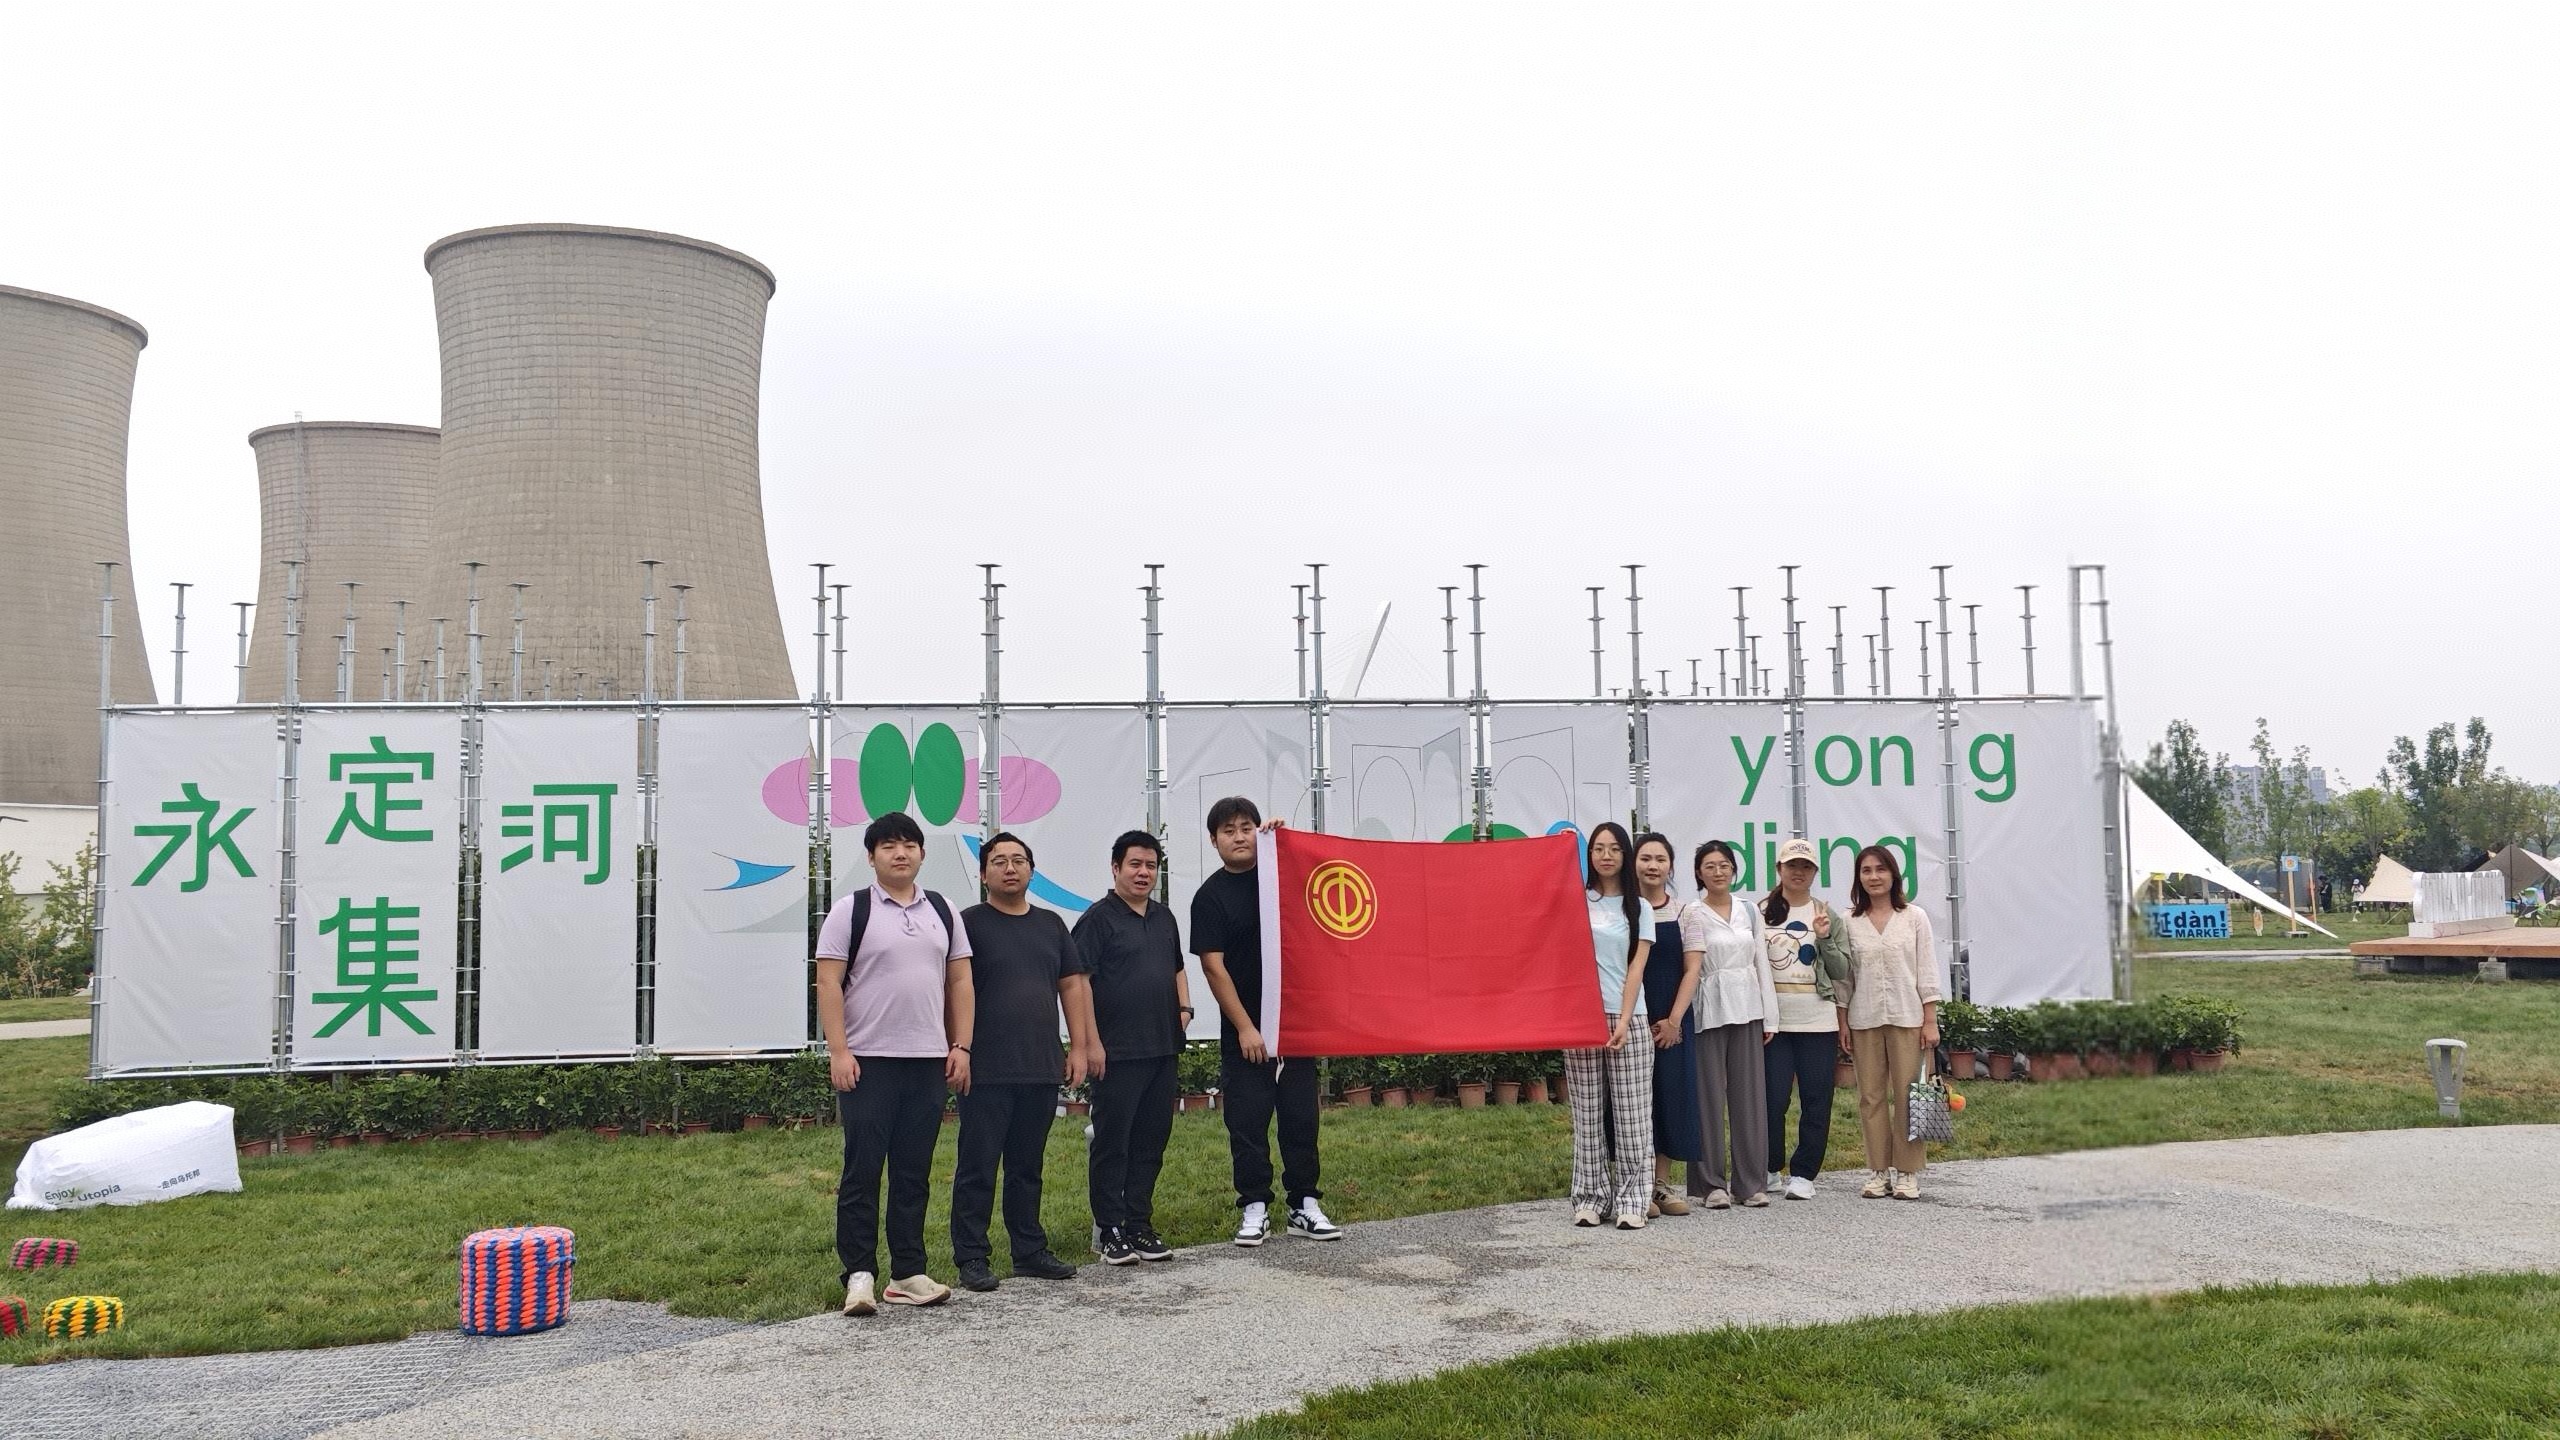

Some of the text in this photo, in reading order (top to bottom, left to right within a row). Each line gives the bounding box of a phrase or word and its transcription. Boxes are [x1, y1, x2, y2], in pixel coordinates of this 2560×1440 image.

[2175, 928, 2227, 938] MARKET
[311, 896, 438, 1038] 集
[44, 1187, 76, 1201] Enjoy
